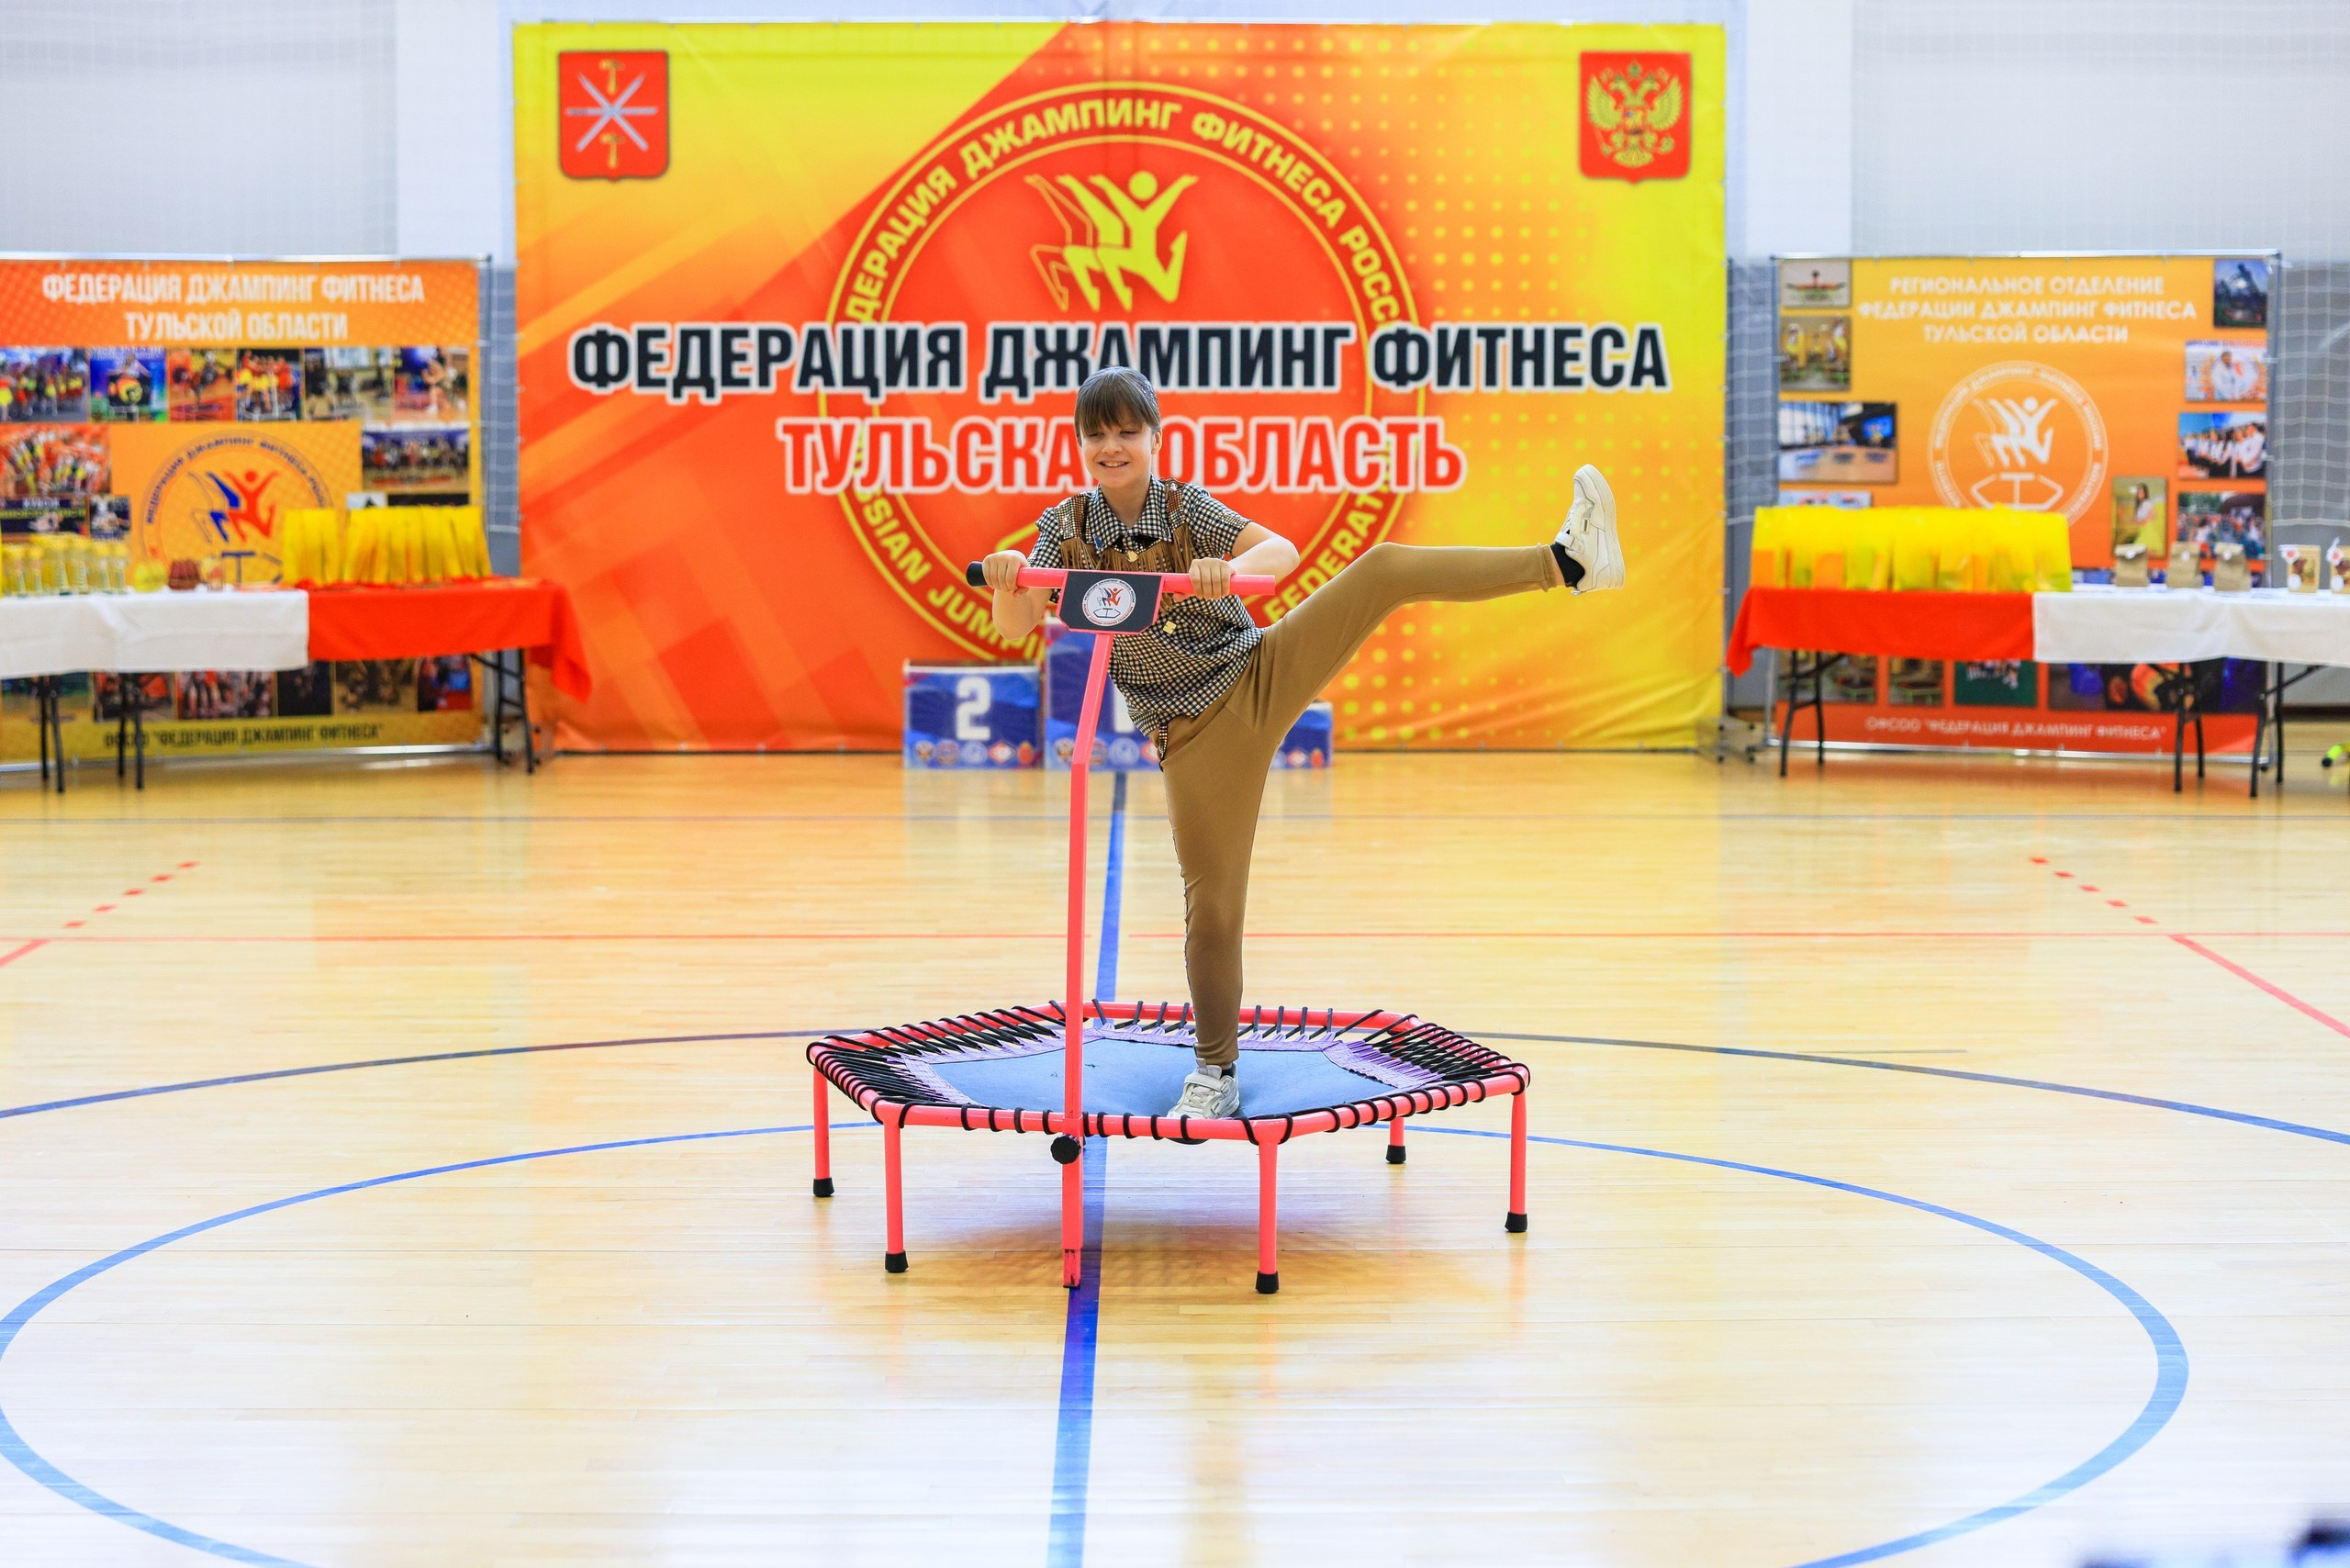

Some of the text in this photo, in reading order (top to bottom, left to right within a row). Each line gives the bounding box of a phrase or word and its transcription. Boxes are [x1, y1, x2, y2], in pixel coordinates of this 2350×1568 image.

[845, 97, 1401, 323] ДЕРАЦИЯ ДЖАМПИНГ ФИТНЕСА РОСС
[43, 273, 425, 305] ФЕДЕРАЦИЯ ДЖАМПИНГ ФИТНЕСА
[1890, 275, 2165, 297] РЕГИОНАЛЬНОЕ ОТДЕЛЕНИЕ
[124, 308, 349, 342] ТУЛЬСКОЙ ОБЛАСТИ
[1857, 300, 2198, 321] ФЕДЕРАЦИИ ДЖАМПИНГ ФИТНЕСА
[1923, 321, 2129, 344] ТУЛЬСКОЙ ОБЛАСТИ
[570, 322, 1670, 402] ФЕДЕРАЦИЯ ДЖАМПИНГ ФИТНЕСА
[777, 417, 1466, 494] ТУЛЬСКА ОБЛАСТЬ
[955, 677, 991, 741] 2
